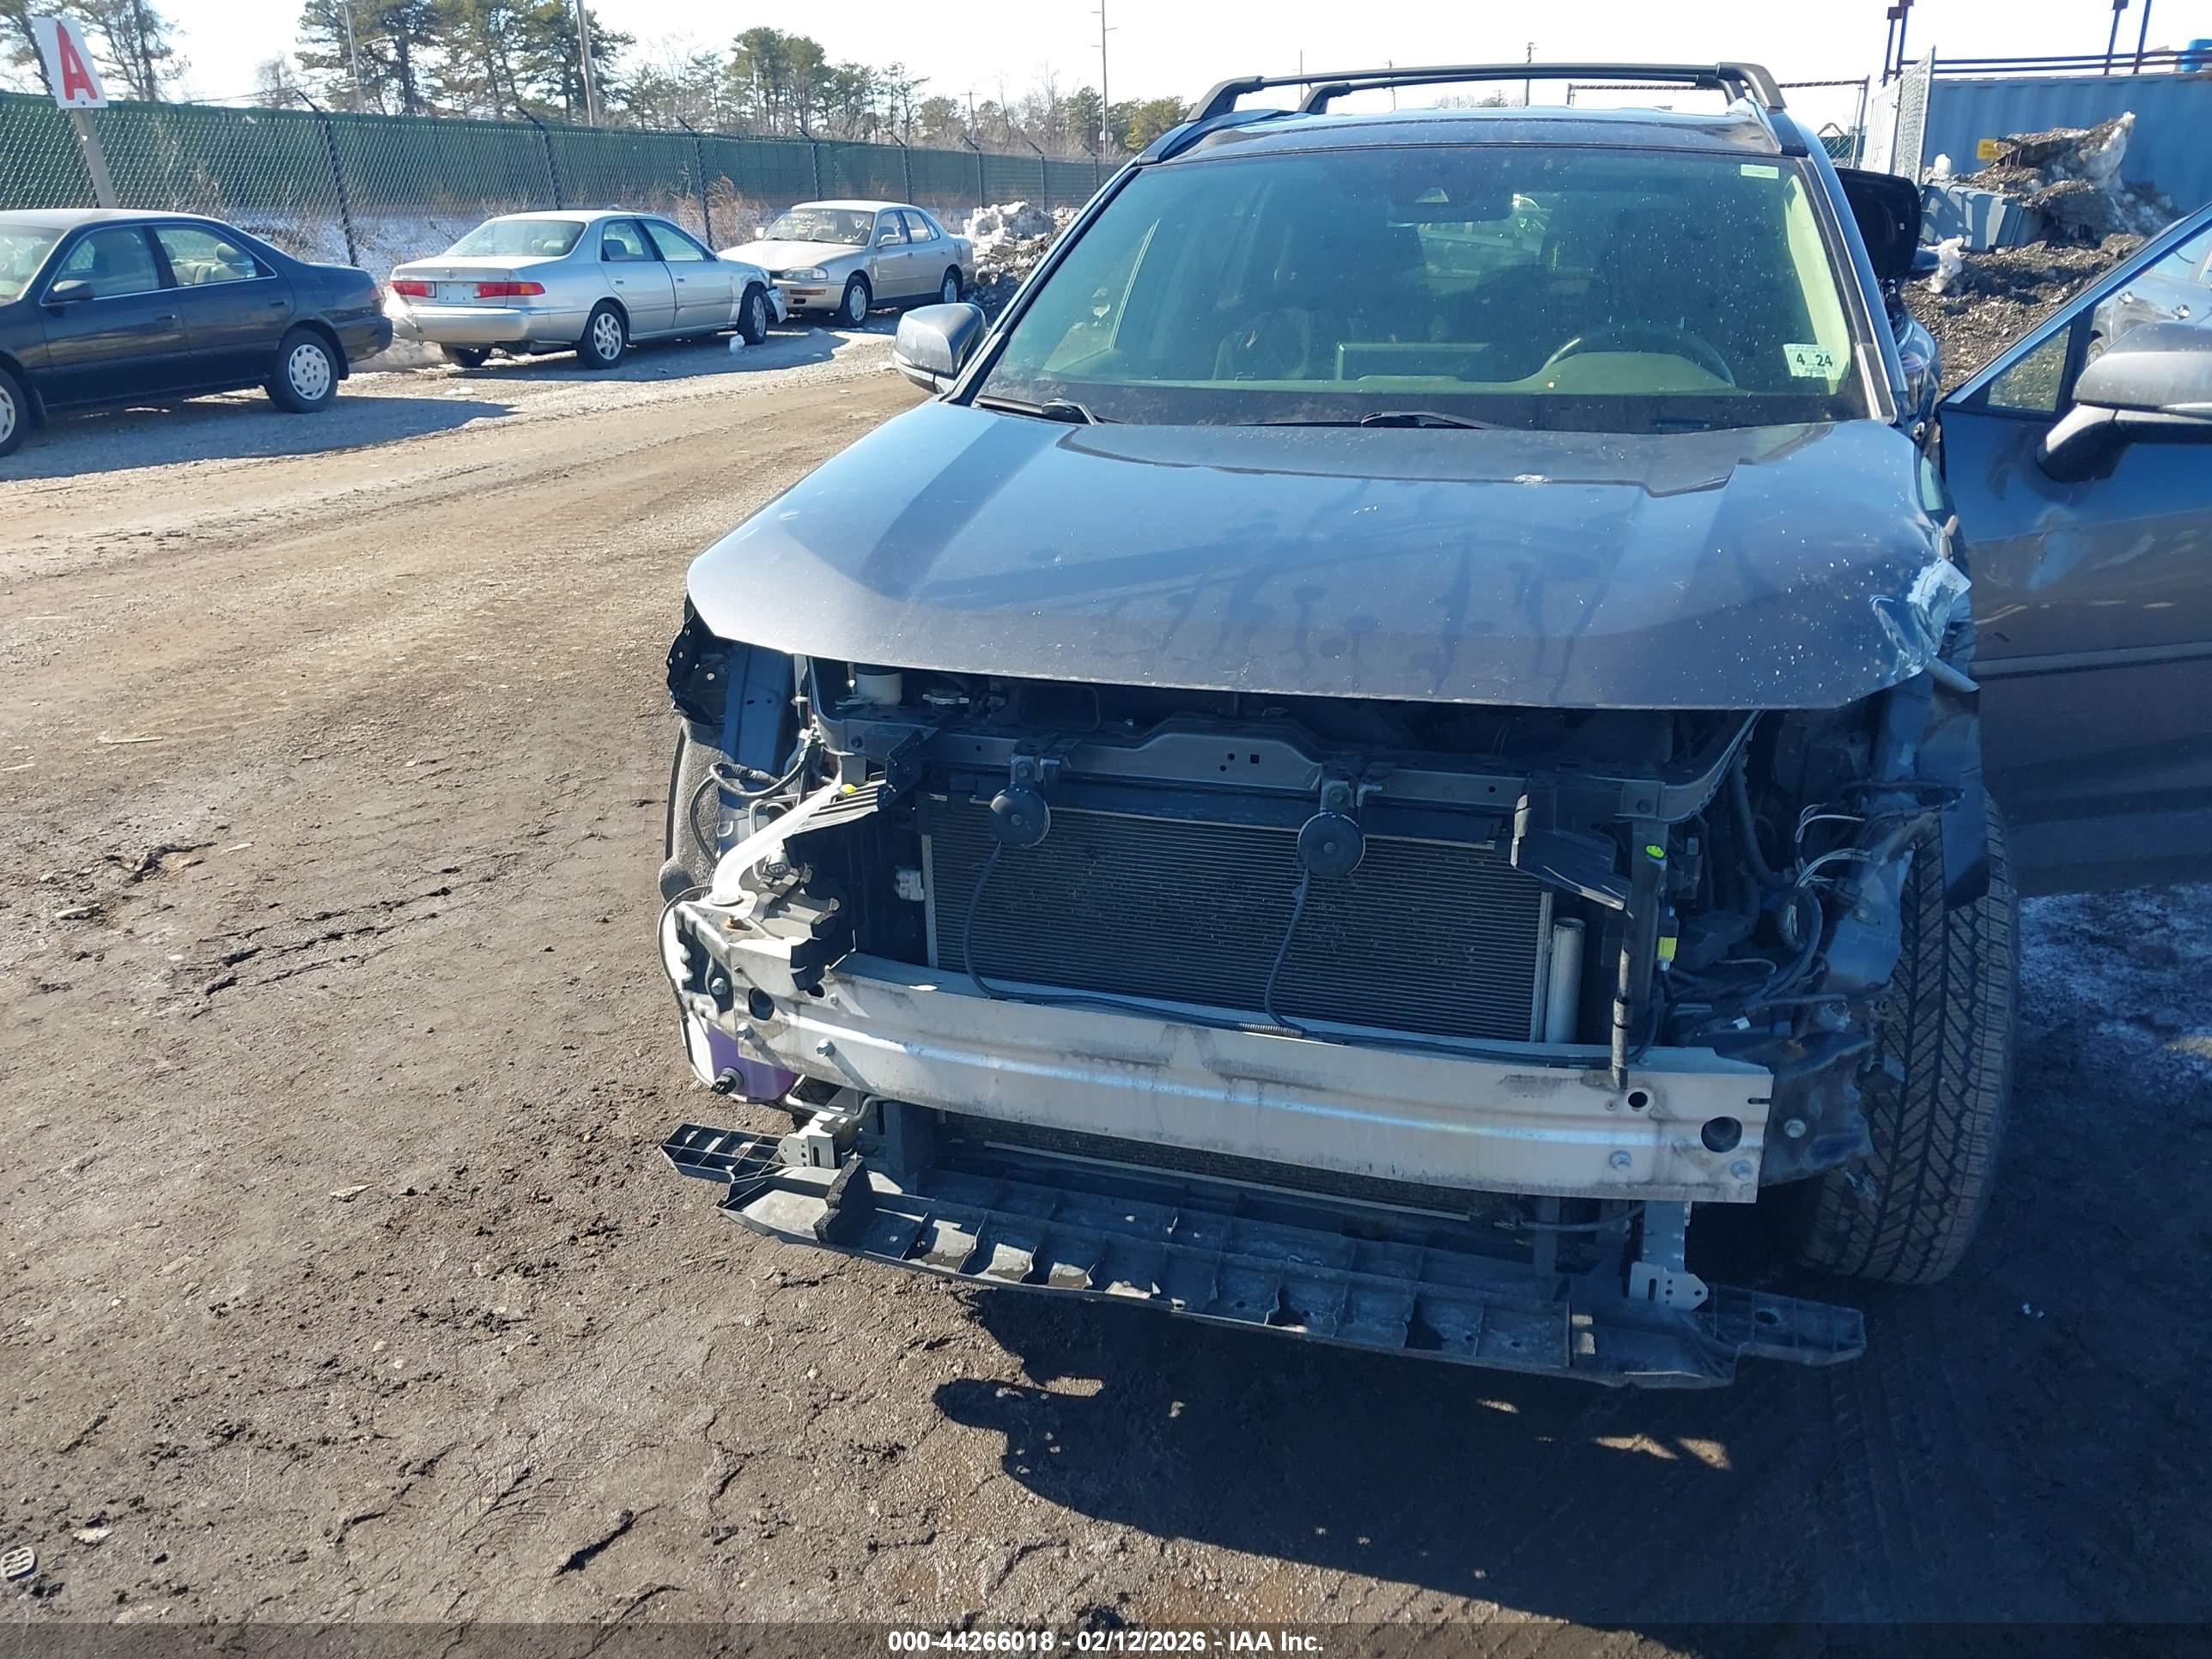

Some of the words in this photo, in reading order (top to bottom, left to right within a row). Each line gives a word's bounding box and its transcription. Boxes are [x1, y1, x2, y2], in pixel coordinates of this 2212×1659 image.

[56, 22, 98, 100] A
[1796, 353, 1806, 366] 4
[1815, 354, 1833, 368] 24
